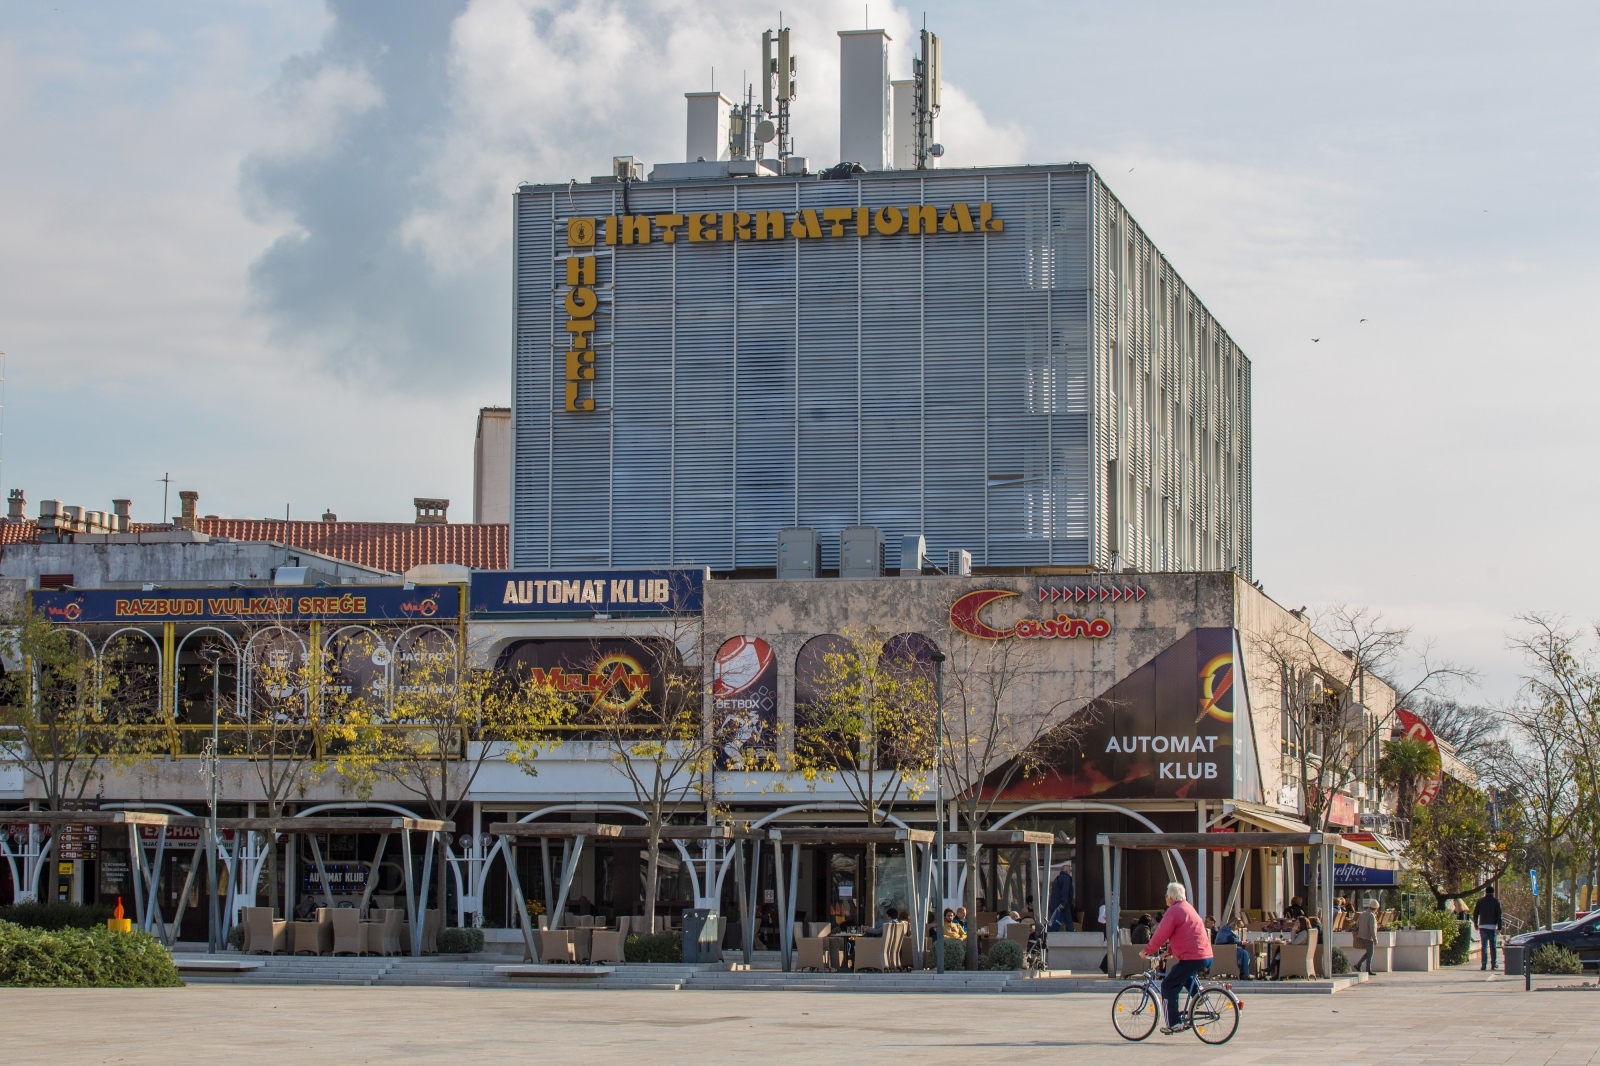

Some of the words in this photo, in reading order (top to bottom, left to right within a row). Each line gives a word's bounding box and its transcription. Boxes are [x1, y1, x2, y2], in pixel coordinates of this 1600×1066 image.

[605, 202, 1004, 246] INTERNATIONAL
[564, 256, 598, 412] HOTEL
[502, 580, 607, 604] AUTOMAT
[610, 579, 670, 603] KLUB
[115, 598, 204, 616] RAZBUDI
[208, 598, 293, 615] VULKAN
[298, 593, 367, 614] SREĆE
[949, 589, 1112, 640] Casino
[716, 699, 760, 709] BETBOX
[1105, 736, 1218, 753] AUTOMAT
[1159, 762, 1218, 779] KLUB
[345, 872, 364, 882] KLUB
